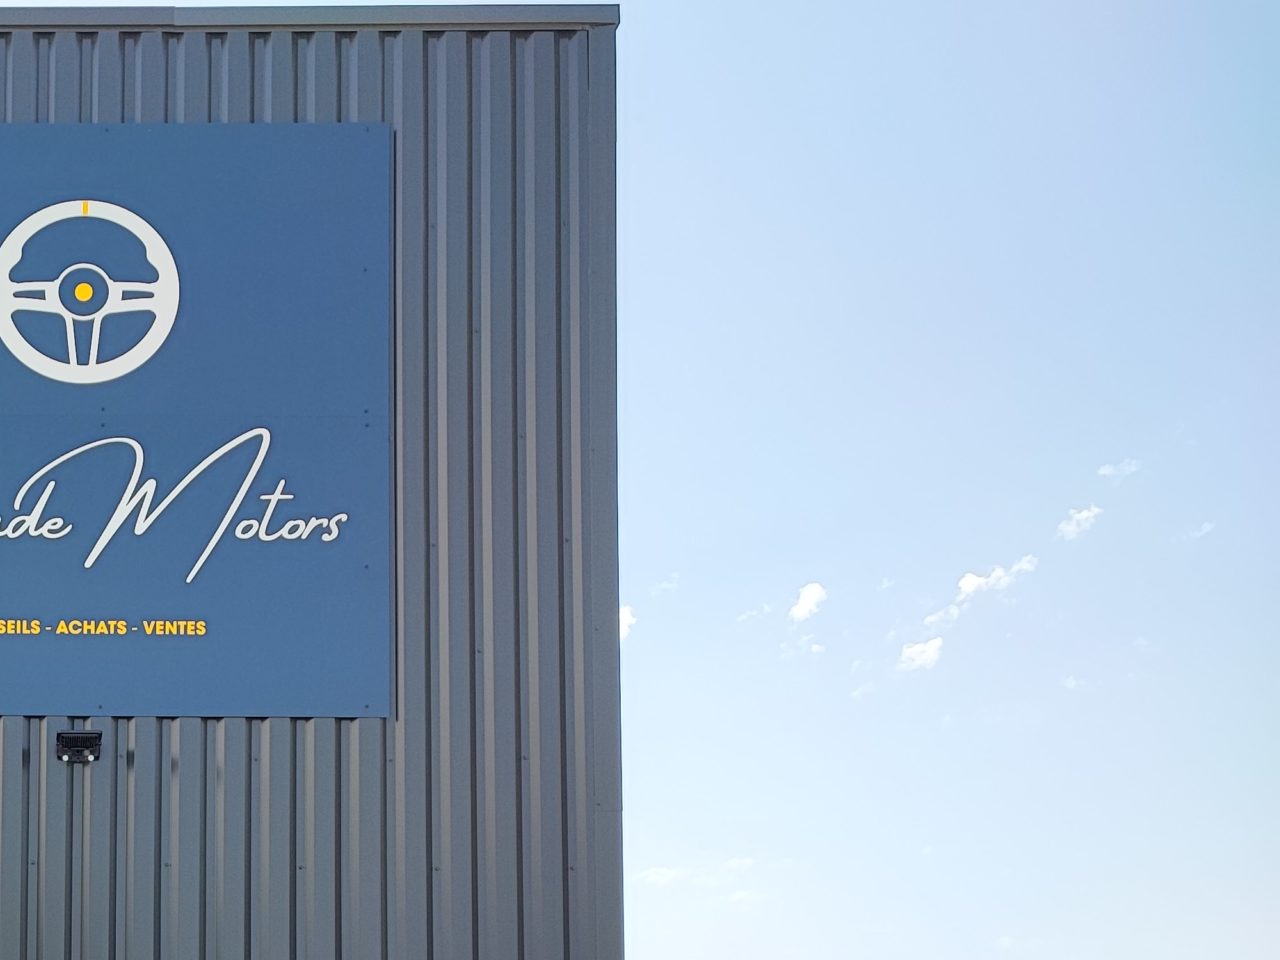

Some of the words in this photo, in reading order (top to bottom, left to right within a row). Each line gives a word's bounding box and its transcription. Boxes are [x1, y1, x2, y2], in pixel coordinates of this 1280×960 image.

[14, 427, 348, 584] Motors
[55, 619, 128, 636] ACHATS
[142, 620, 207, 636] VENTES
